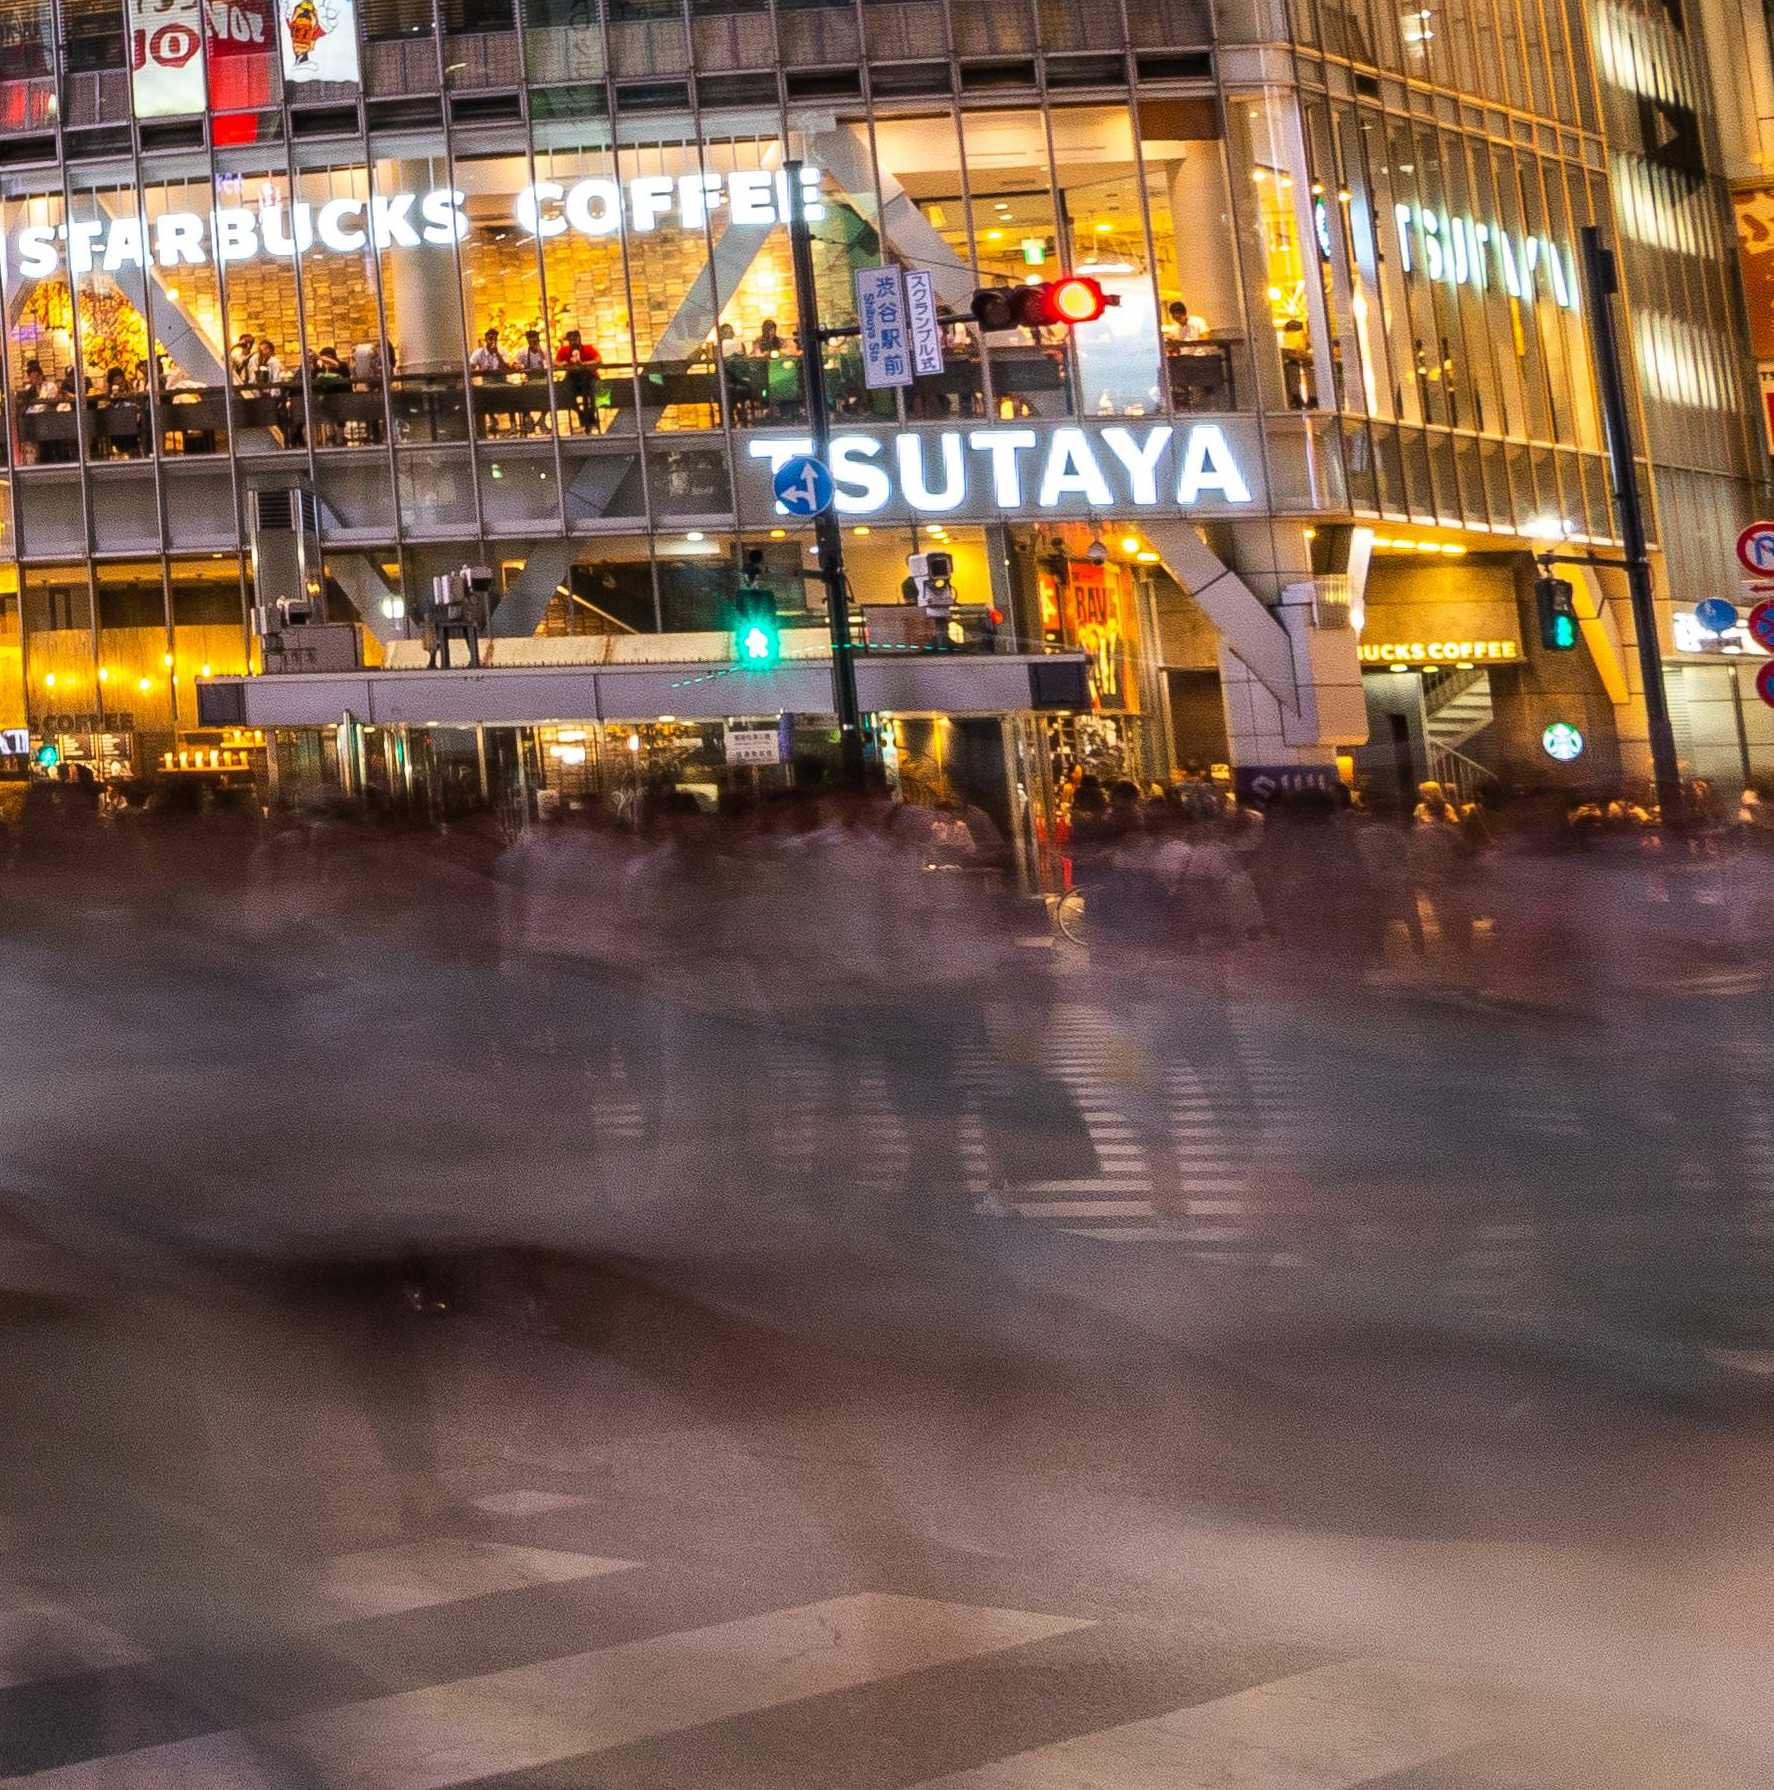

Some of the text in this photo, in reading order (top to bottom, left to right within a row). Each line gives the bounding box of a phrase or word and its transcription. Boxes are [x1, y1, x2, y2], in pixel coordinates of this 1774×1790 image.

[17, 166, 826, 280] STARBUCKS COFFEE
[864, 293, 876, 339] Shibuya
[876, 276, 904, 377] 渋谷駅前
[912, 276, 937, 371] スクランブル式
[748, 423, 1252, 517] TSUTAYA
[1426, 640, 1517, 660] COFFEE
